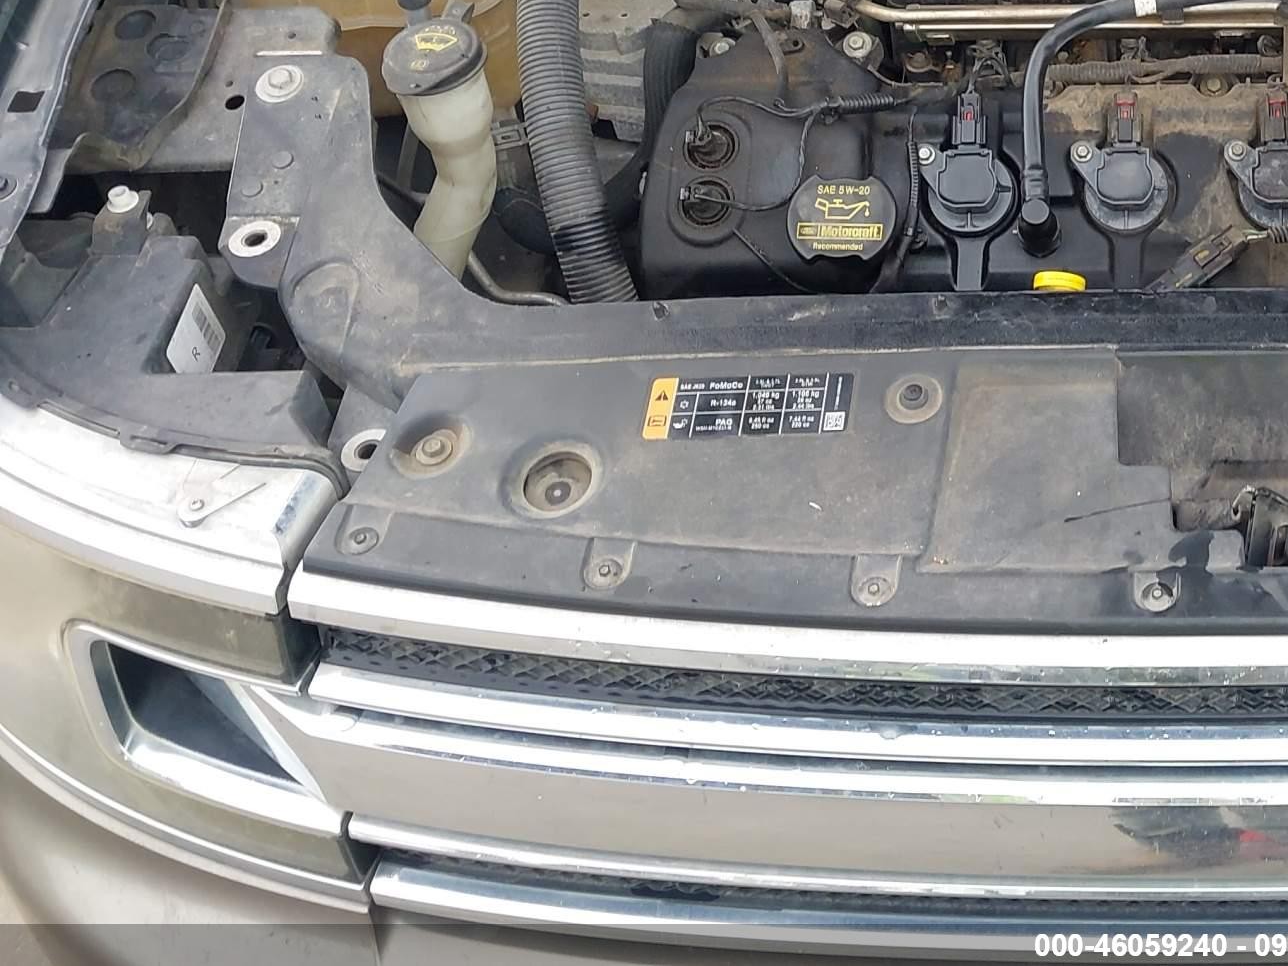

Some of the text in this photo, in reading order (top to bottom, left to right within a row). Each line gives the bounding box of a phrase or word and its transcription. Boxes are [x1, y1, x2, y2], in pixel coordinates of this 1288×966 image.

[817, 184, 871, 195] SAE 5W-20
[821, 225, 879, 238] Motorcraft
[812, 241, 864, 251] Recommended
[709, 381, 744, 390] FoMoCo
[710, 398, 737, 407] R-134a
[715, 418, 733, 426] PAG
